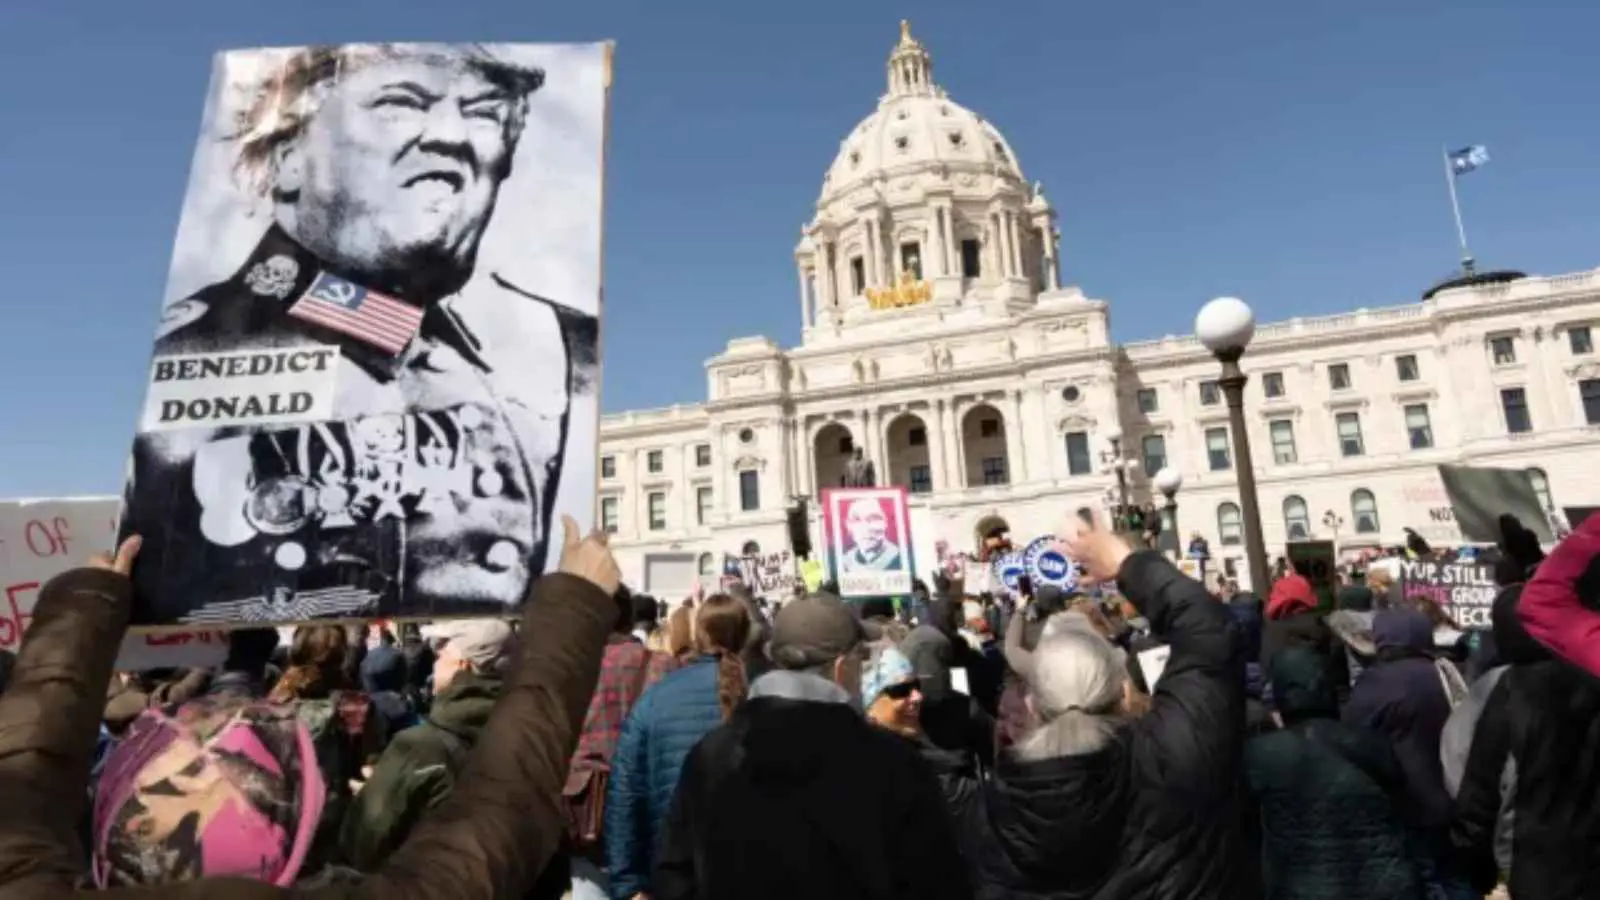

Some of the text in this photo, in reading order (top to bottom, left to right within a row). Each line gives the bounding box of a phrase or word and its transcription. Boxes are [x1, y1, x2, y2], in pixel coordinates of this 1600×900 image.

[153, 351, 333, 382] BENEDICT
[159, 391, 313, 422] DONALD
[1401, 560, 1495, 585] YUP, STILL
[1452, 586, 1496, 604] GROUP
